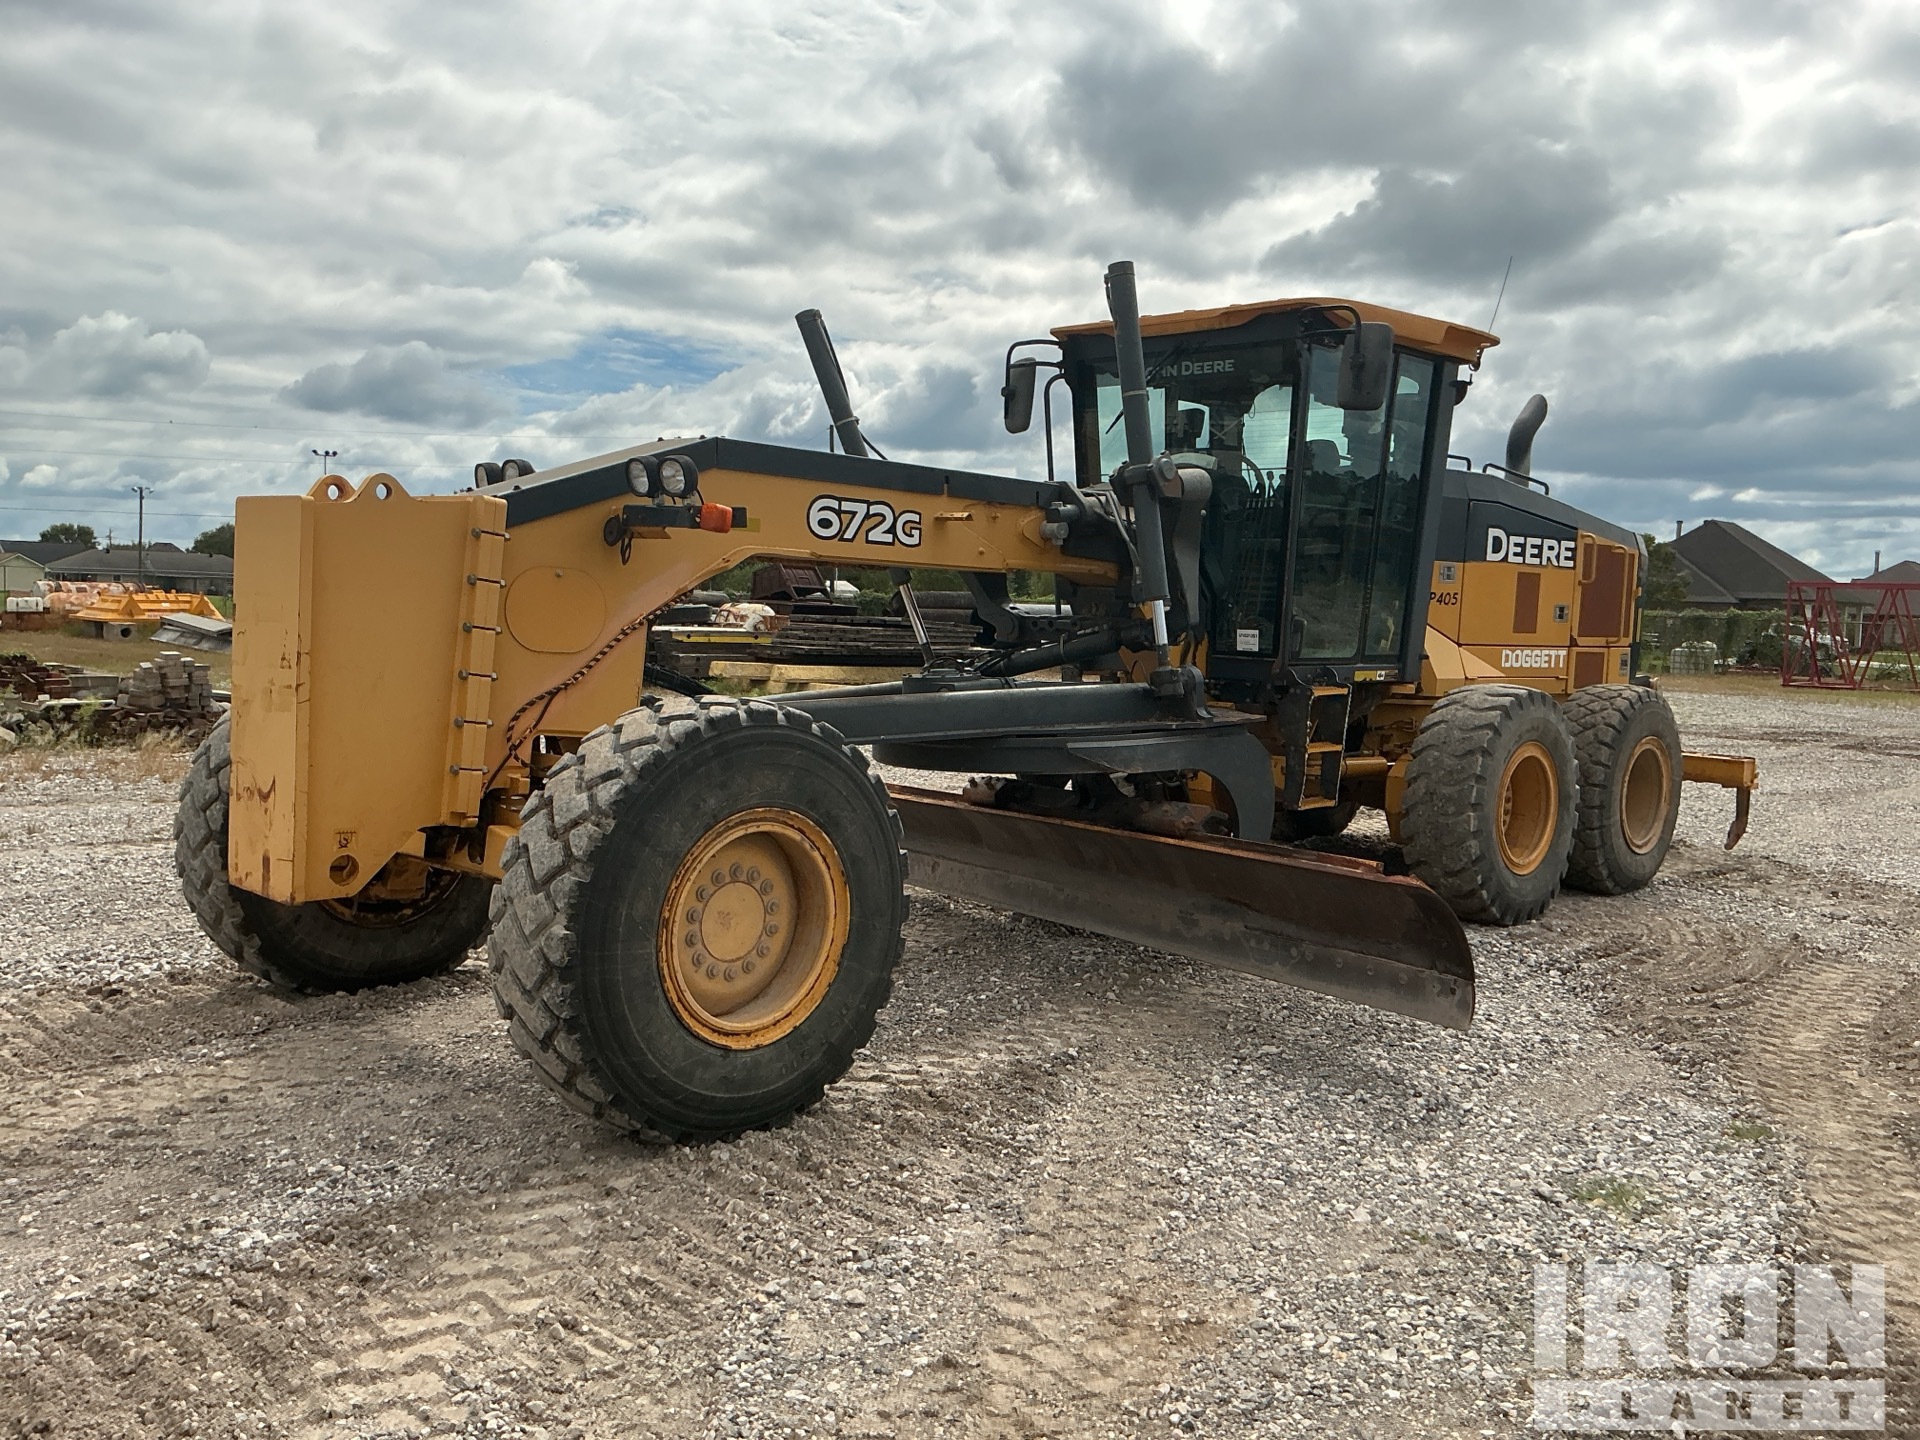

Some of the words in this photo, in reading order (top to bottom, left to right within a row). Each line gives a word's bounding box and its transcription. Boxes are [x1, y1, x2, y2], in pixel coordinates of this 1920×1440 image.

[1181, 360, 1235, 376] DEERE
[807, 494, 922, 548] 672G
[1486, 527, 1576, 568] DEERE
[1501, 648, 1567, 668] DOGGETT
